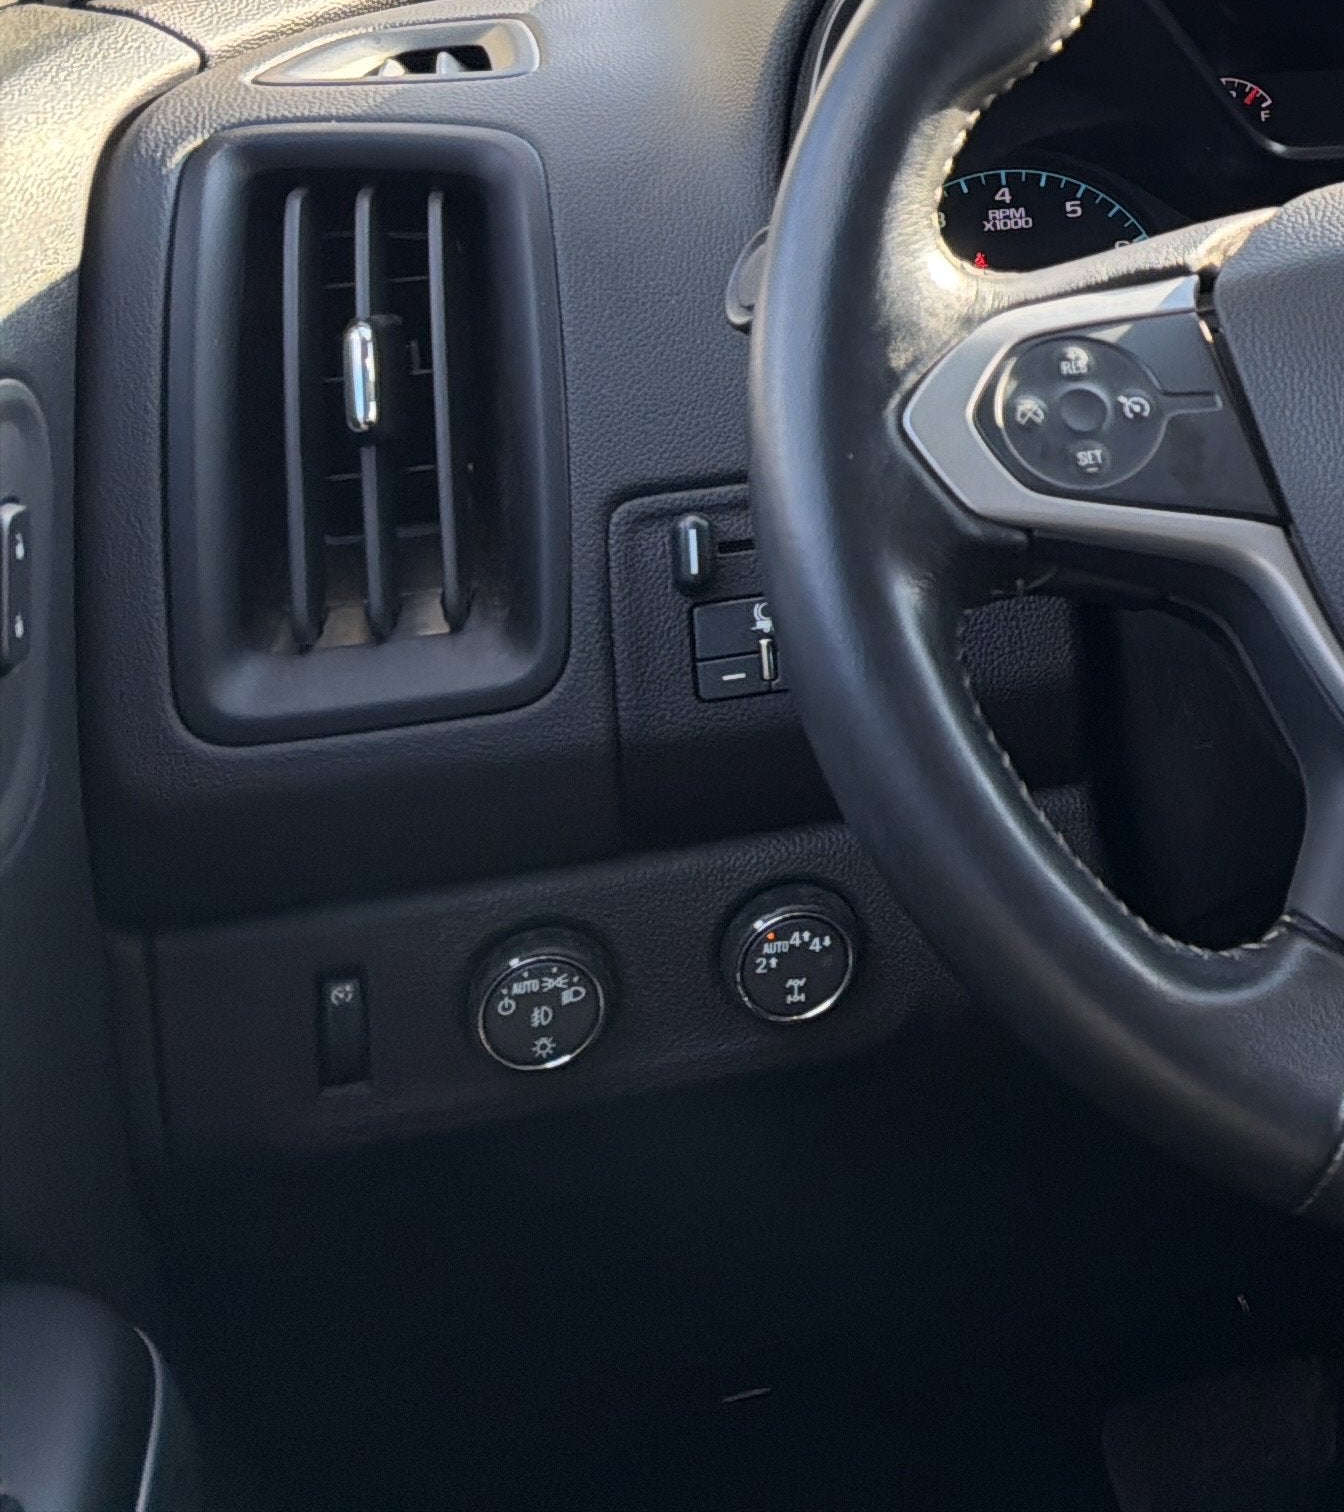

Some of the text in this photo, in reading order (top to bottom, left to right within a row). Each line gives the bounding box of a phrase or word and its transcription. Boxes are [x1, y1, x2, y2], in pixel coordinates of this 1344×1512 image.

[1260, 110, 1270, 122] F
[994, 188, 1012, 204] 4
[988, 206, 1026, 221] RPM
[1065, 201, 1082, 218] 5
[1076, 449, 1102, 467] SET
[763, 940, 789, 955] AUTO
[512, 978, 540, 995] AUTO
